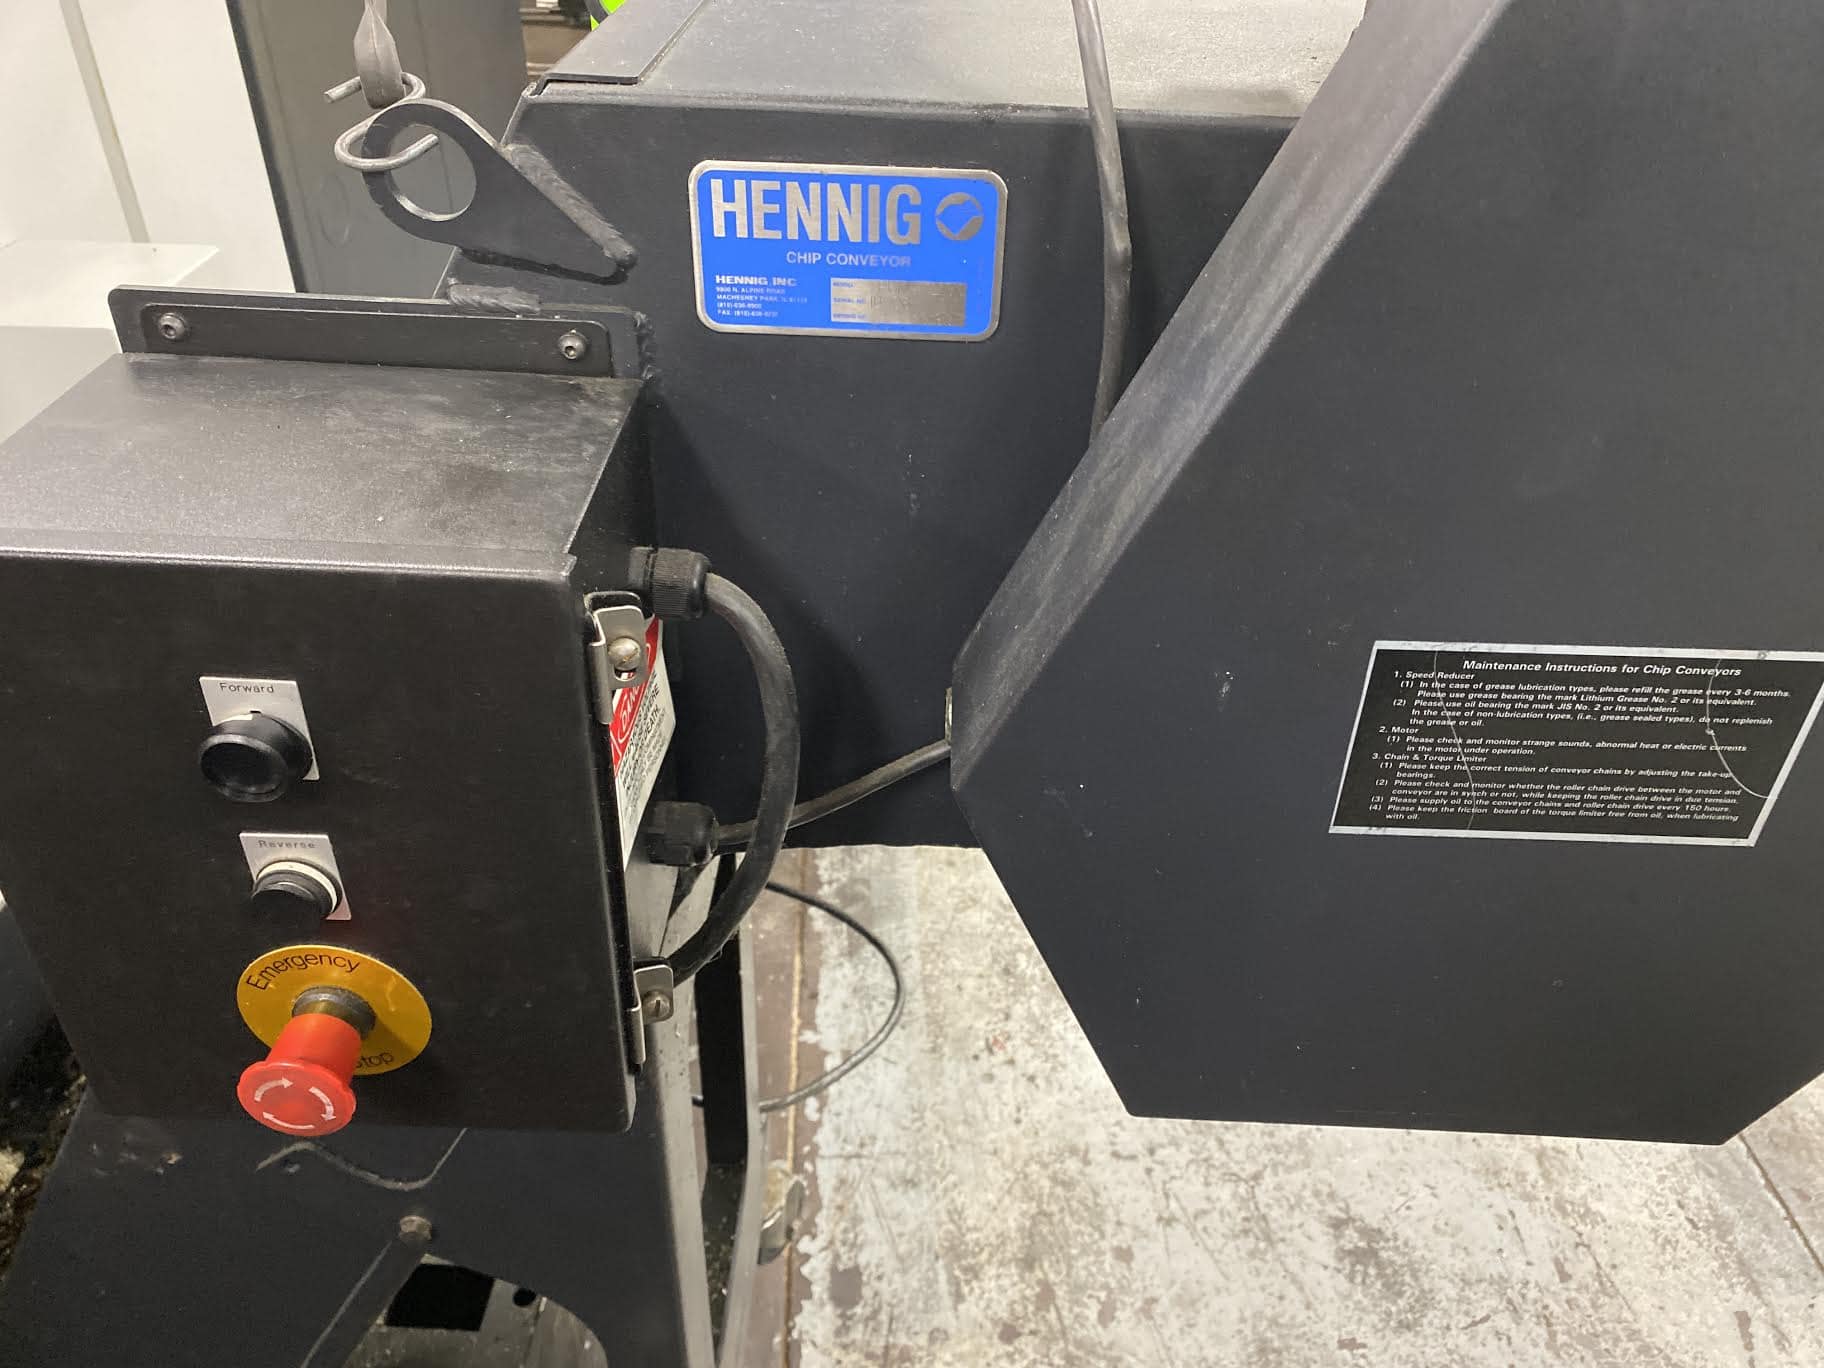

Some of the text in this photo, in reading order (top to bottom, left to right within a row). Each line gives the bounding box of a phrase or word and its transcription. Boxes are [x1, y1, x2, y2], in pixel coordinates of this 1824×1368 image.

[710, 178, 922, 246] HENNIG
[786, 251, 912, 268] CHIP CONVEYOR
[715, 274, 768, 286] HENNIG
[1394, 670, 1475, 680] 1. Speed Reducer
[1462, 660, 1742, 678] Maintenance Instructions for Chip Conveyors
[219, 681, 275, 694] Forward
[1400, 680, 1414, 689] (1)
[1419, 680, 1429, 688] In
[1431, 679, 1447, 689] the
[1472, 682, 1484, 690] of
[1484, 683, 1516, 691] grease
[1517, 683, 1566, 692] lubrication
[1599, 685, 1630, 694] please
[1631, 686, 1654, 694] refill
[1654, 686, 1671, 694] the
[1672, 688, 1704, 696] grease
[1705, 688, 1732, 698] every
[1734, 688, 1752, 697] 3-6
[1417, 688, 1447, 698] Please
[1467, 692, 1499, 700] grease
[1500, 692, 1535, 702] bearing
[1537, 693, 1553, 701] the
[1580, 694, 1615, 702] Lithium
[1616, 694, 1649, 703] Grease
[1650, 695, 1667, 703] No.
[1670, 696, 1679, 704] 2
[1692, 697, 1705, 705] its
[1706, 696, 1757, 707] equivalent.
[1392, 698, 1407, 707] (2)
[1413, 698, 1444, 707] Please
[1464, 700, 1477, 708] oil
[1478, 700, 1512, 710] bearing
[1531, 702, 1554, 710] mark
[1574, 703, 1591, 711] No.
[1593, 703, 1601, 711] 2
[1614, 704, 1627, 712] its
[1628, 705, 1679, 713] equivalent.
[1409, 717, 1425, 725] the
[1426, 718, 1457, 728] grease
[1411, 708, 1421, 716] In
[1440, 709, 1462, 717] case
[1463, 709, 1475, 717] of
[1476, 710, 1544, 719] non-lubrication
[1599, 714, 1631, 722] grease
[1632, 714, 1663, 722] sealed
[1731, 717, 1773, 726] replenish
[1378, 725, 1420, 734] 2. Motor
[1386, 735, 1401, 744] (1)
[1405, 735, 1435, 744] Please
[1436, 735, 1464, 745] check
[1465, 737, 1484, 745] and
[1485, 738, 1521, 746] monitor
[1522, 739, 1556, 748] strange
[1595, 740, 1638, 749] abnormal
[1639, 742, 1660, 750] heat
[1673, 743, 1708, 751] electric
[1709, 743, 1747, 751] currents
[1406, 744, 1415, 752] in
[1434, 745, 1462, 754] motor
[1463, 746, 1490, 754] under
[1491, 747, 1536, 755] operation.
[1384, 752, 1410, 761] Chain
[1412, 753, 1420, 761] &
[1423, 753, 1454, 763] Torque
[1379, 761, 1393, 769] (1)
[1398, 762, 1427, 770] Please
[1429, 762, 1451, 771] keep
[1453, 763, 1469, 771] the
[1504, 765, 1536, 773] tension
[1550, 767, 1592, 775] conveyor
[1593, 767, 1622, 775] chains
[1623, 768, 1636, 776] by
[1396, 770, 1436, 780] bearings.
[1375, 778, 1389, 786] (2)
[1393, 779, 1422, 787] Please
[1424, 780, 1451, 788] check
[1508, 782, 1545, 790] whether
[1546, 783, 1561, 791] the
[1562, 783, 1586, 791] roller
[1587, 784, 1611, 792] chain
[1613, 785, 1636, 793] drive
[1637, 786, 1676, 794] between
[1724, 788, 1742, 796] and
[258, 838, 316, 850] Reverse
[246, 953, 360, 992] Emergency
